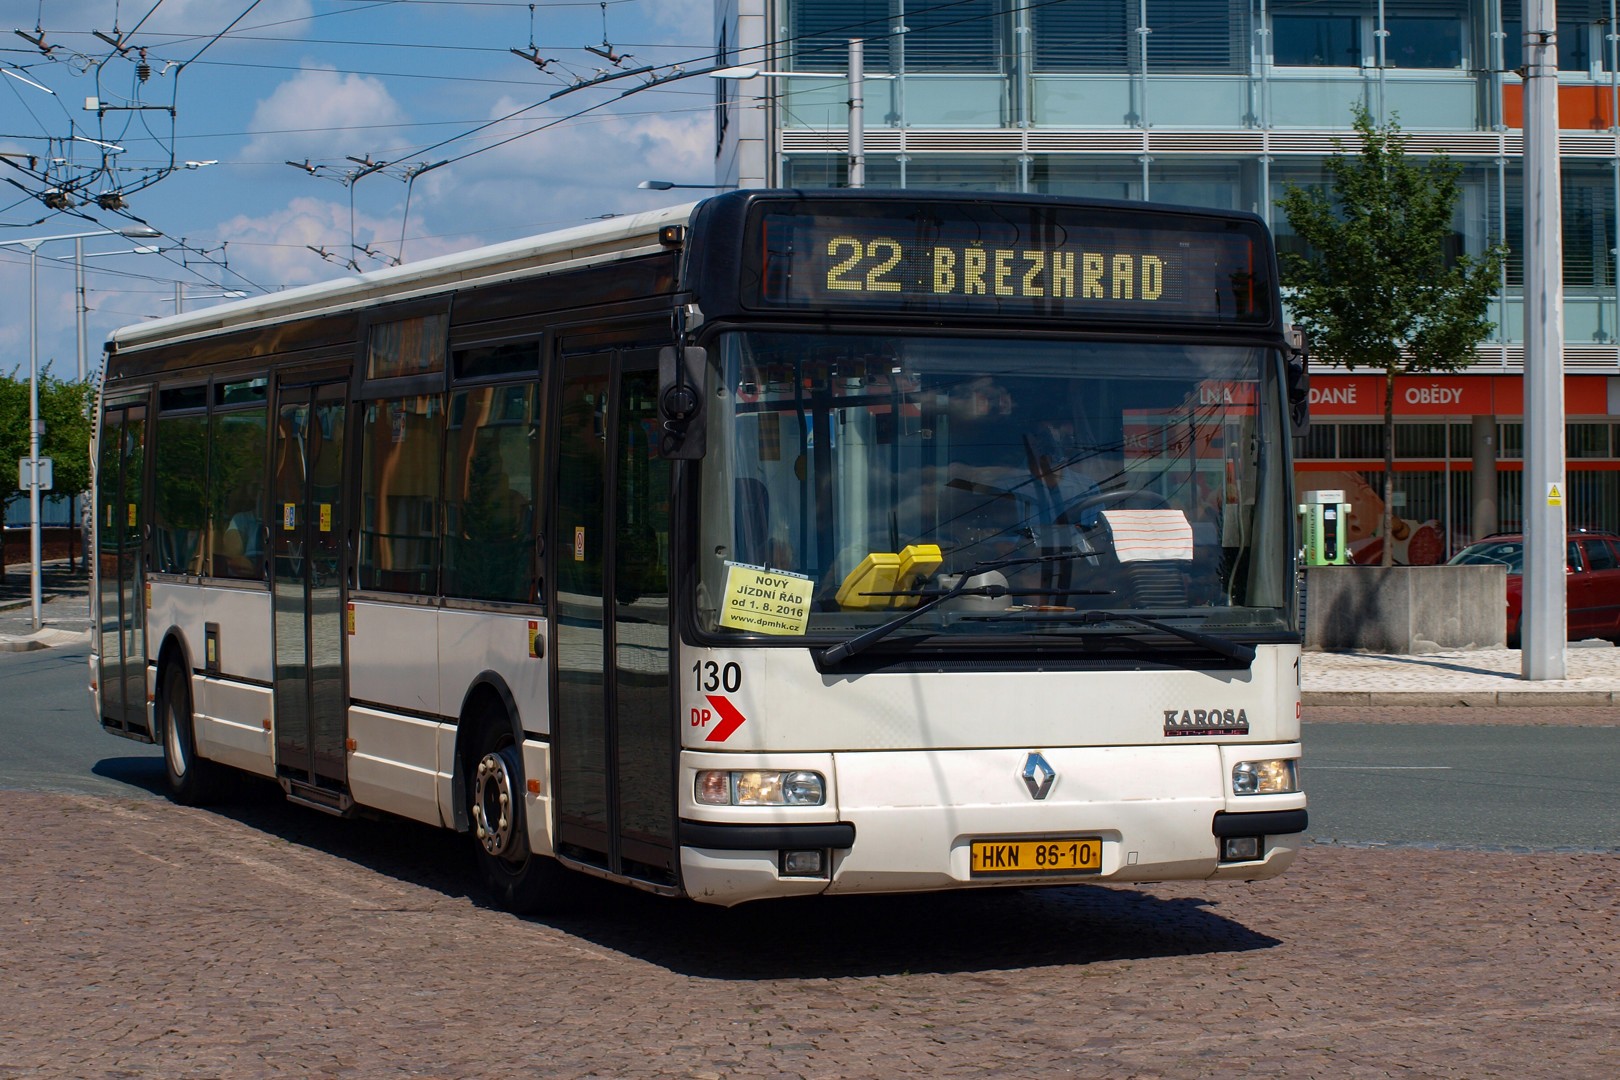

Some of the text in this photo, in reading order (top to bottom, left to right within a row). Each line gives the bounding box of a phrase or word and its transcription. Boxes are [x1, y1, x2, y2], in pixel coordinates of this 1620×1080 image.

[827, 236, 1162, 300] 22 BŘEZHRAD
[1405, 384, 1463, 404] OBĚDY
[756, 576, 789, 589] NOVÝ
[737, 585, 803, 605] JÍZDNÍ ŘÁD
[732, 599, 803, 617] od 1. 8. 2016
[731, 614, 799, 631] www.dpmhk.cz
[693, 660, 742, 693] 130
[691, 708, 712, 727] DP
[1163, 709, 1249, 727] KAROSA
[983, 844, 1091, 867] HKN 86-10
